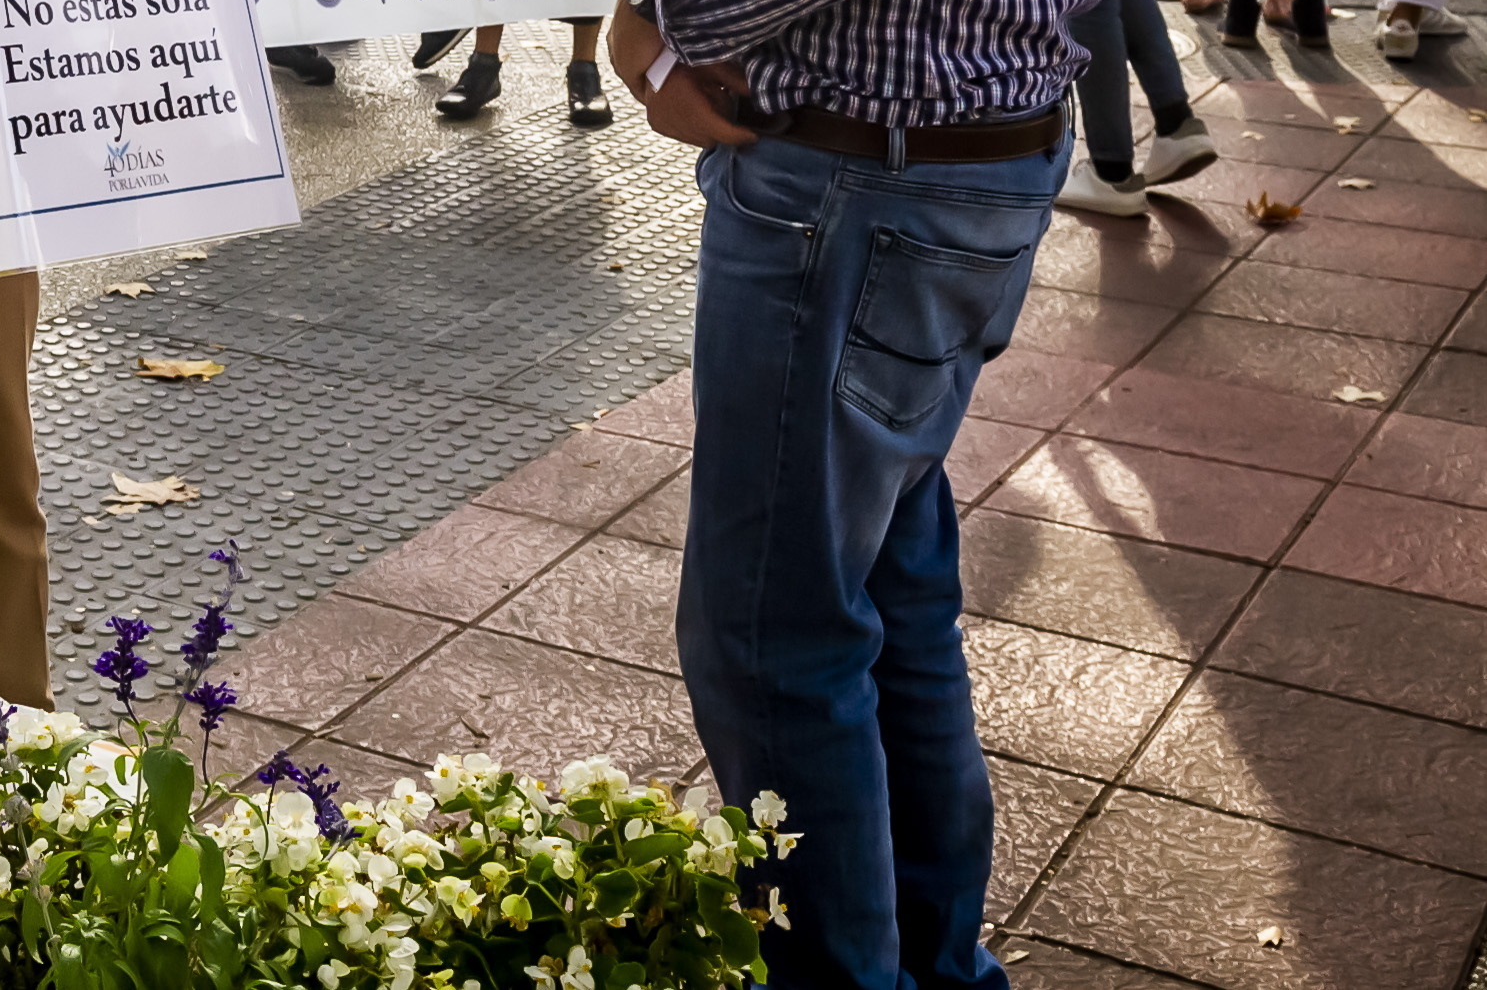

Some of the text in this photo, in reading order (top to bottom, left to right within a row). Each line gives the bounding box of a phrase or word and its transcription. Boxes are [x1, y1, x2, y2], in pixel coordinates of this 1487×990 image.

[0, 28, 223, 84] Estamos aquí
[8, 81, 238, 156] para ayudarte
